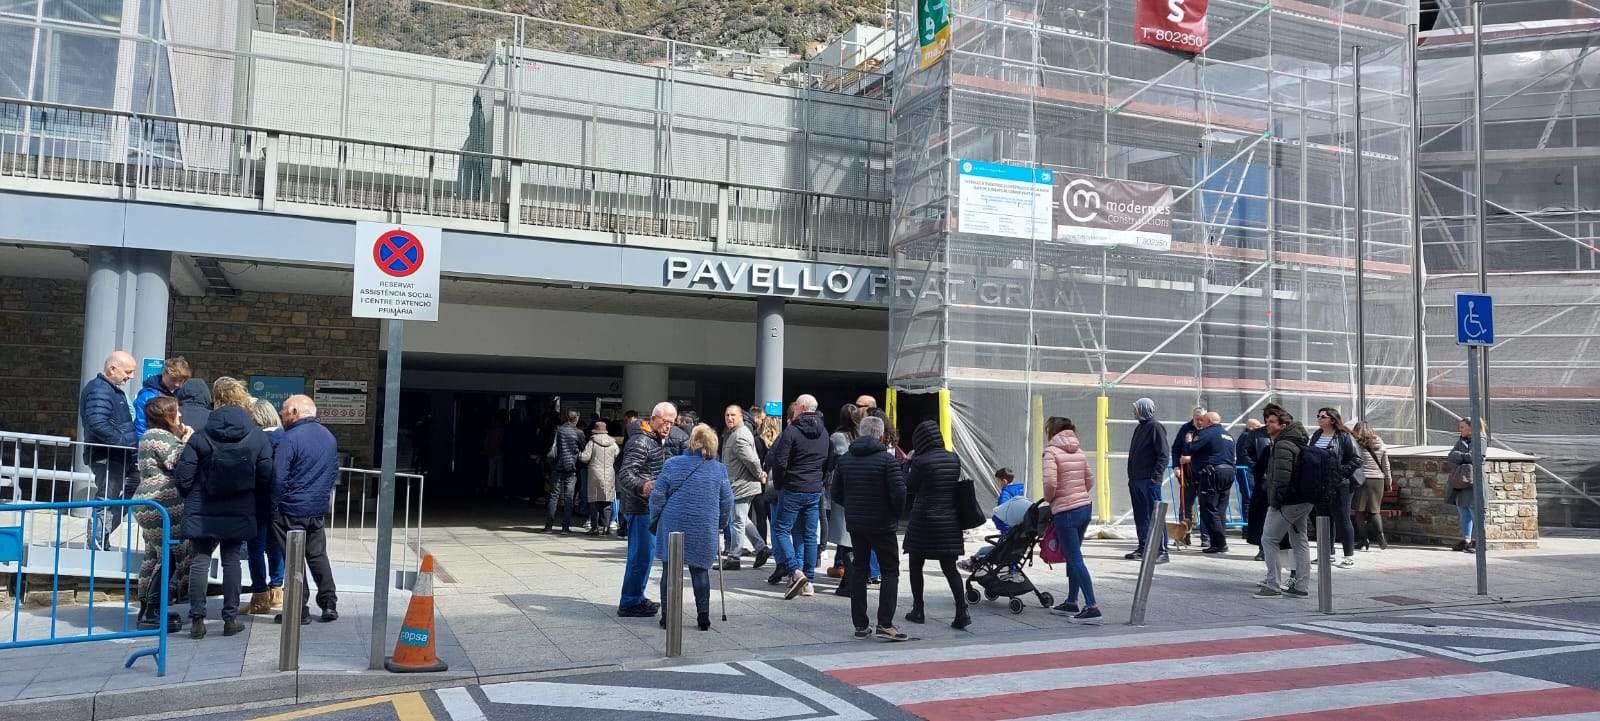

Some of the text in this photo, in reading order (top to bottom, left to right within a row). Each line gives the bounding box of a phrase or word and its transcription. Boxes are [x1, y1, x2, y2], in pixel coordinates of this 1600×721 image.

[1156, 30, 1203, 47] 802350
[379, 281, 415, 289] RESERVAT
[667, 256, 1086, 310] PAVELLÓ PRAT GRN
[407, 291, 432, 299] SOCIAL
[401, 631, 428, 642] copsa
